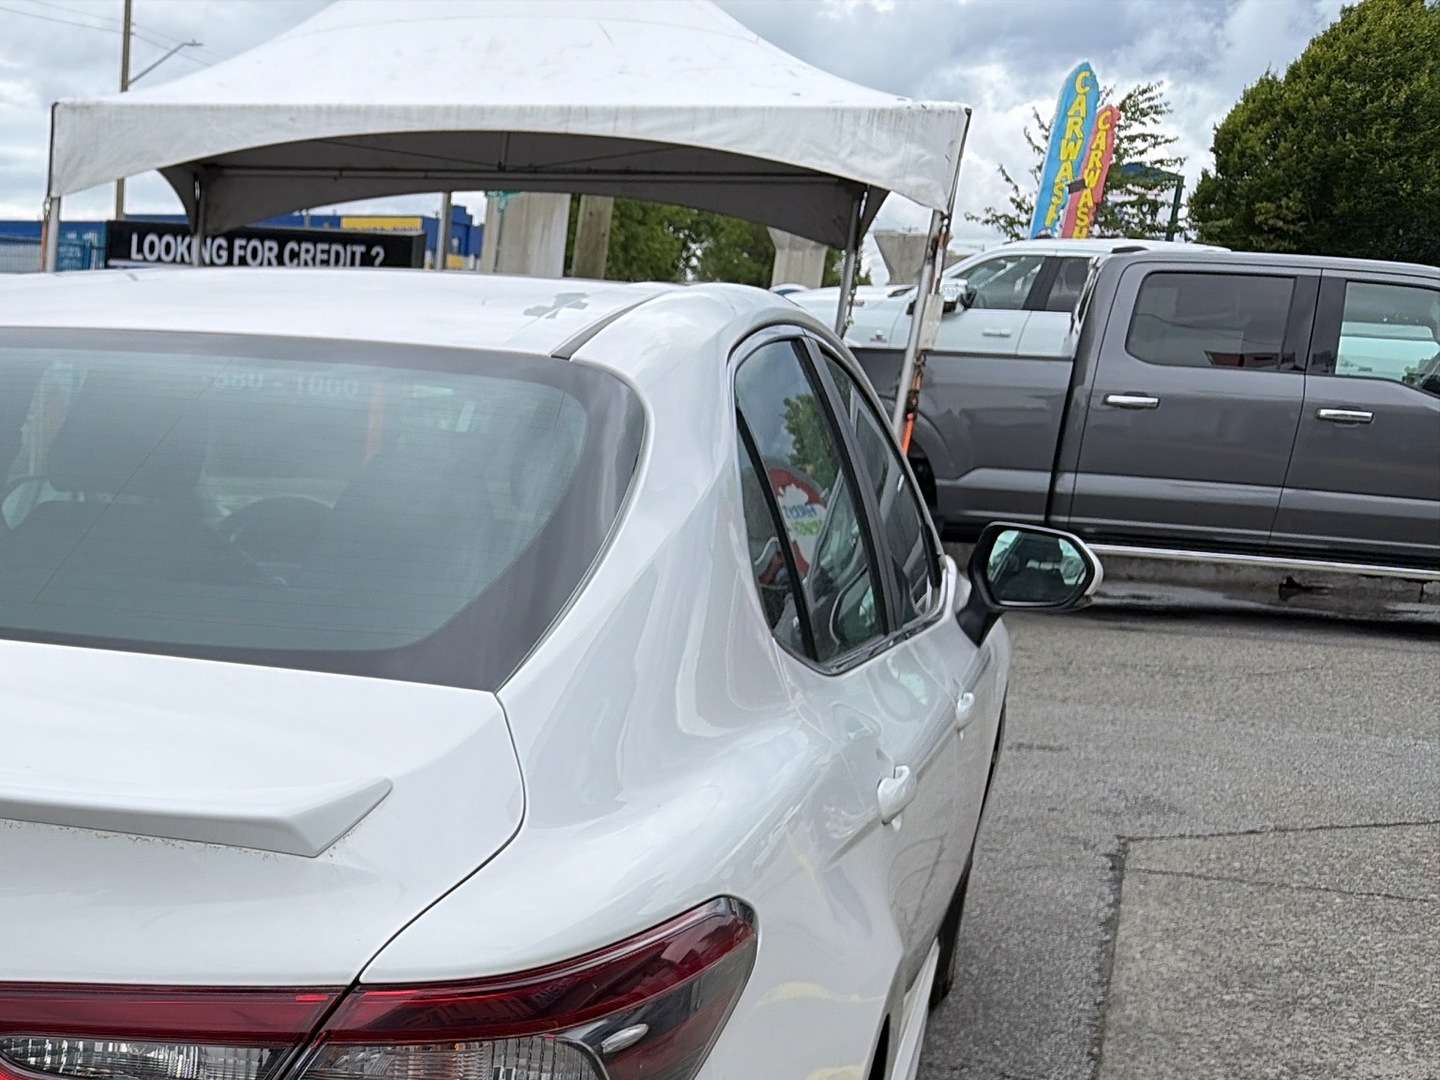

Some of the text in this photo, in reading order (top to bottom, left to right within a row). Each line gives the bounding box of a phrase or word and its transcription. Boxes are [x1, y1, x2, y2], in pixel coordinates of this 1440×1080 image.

[130, 233, 228, 265] LOOKING
[232, 237, 279, 267] FOR
[283, 241, 366, 267] CREDIT
